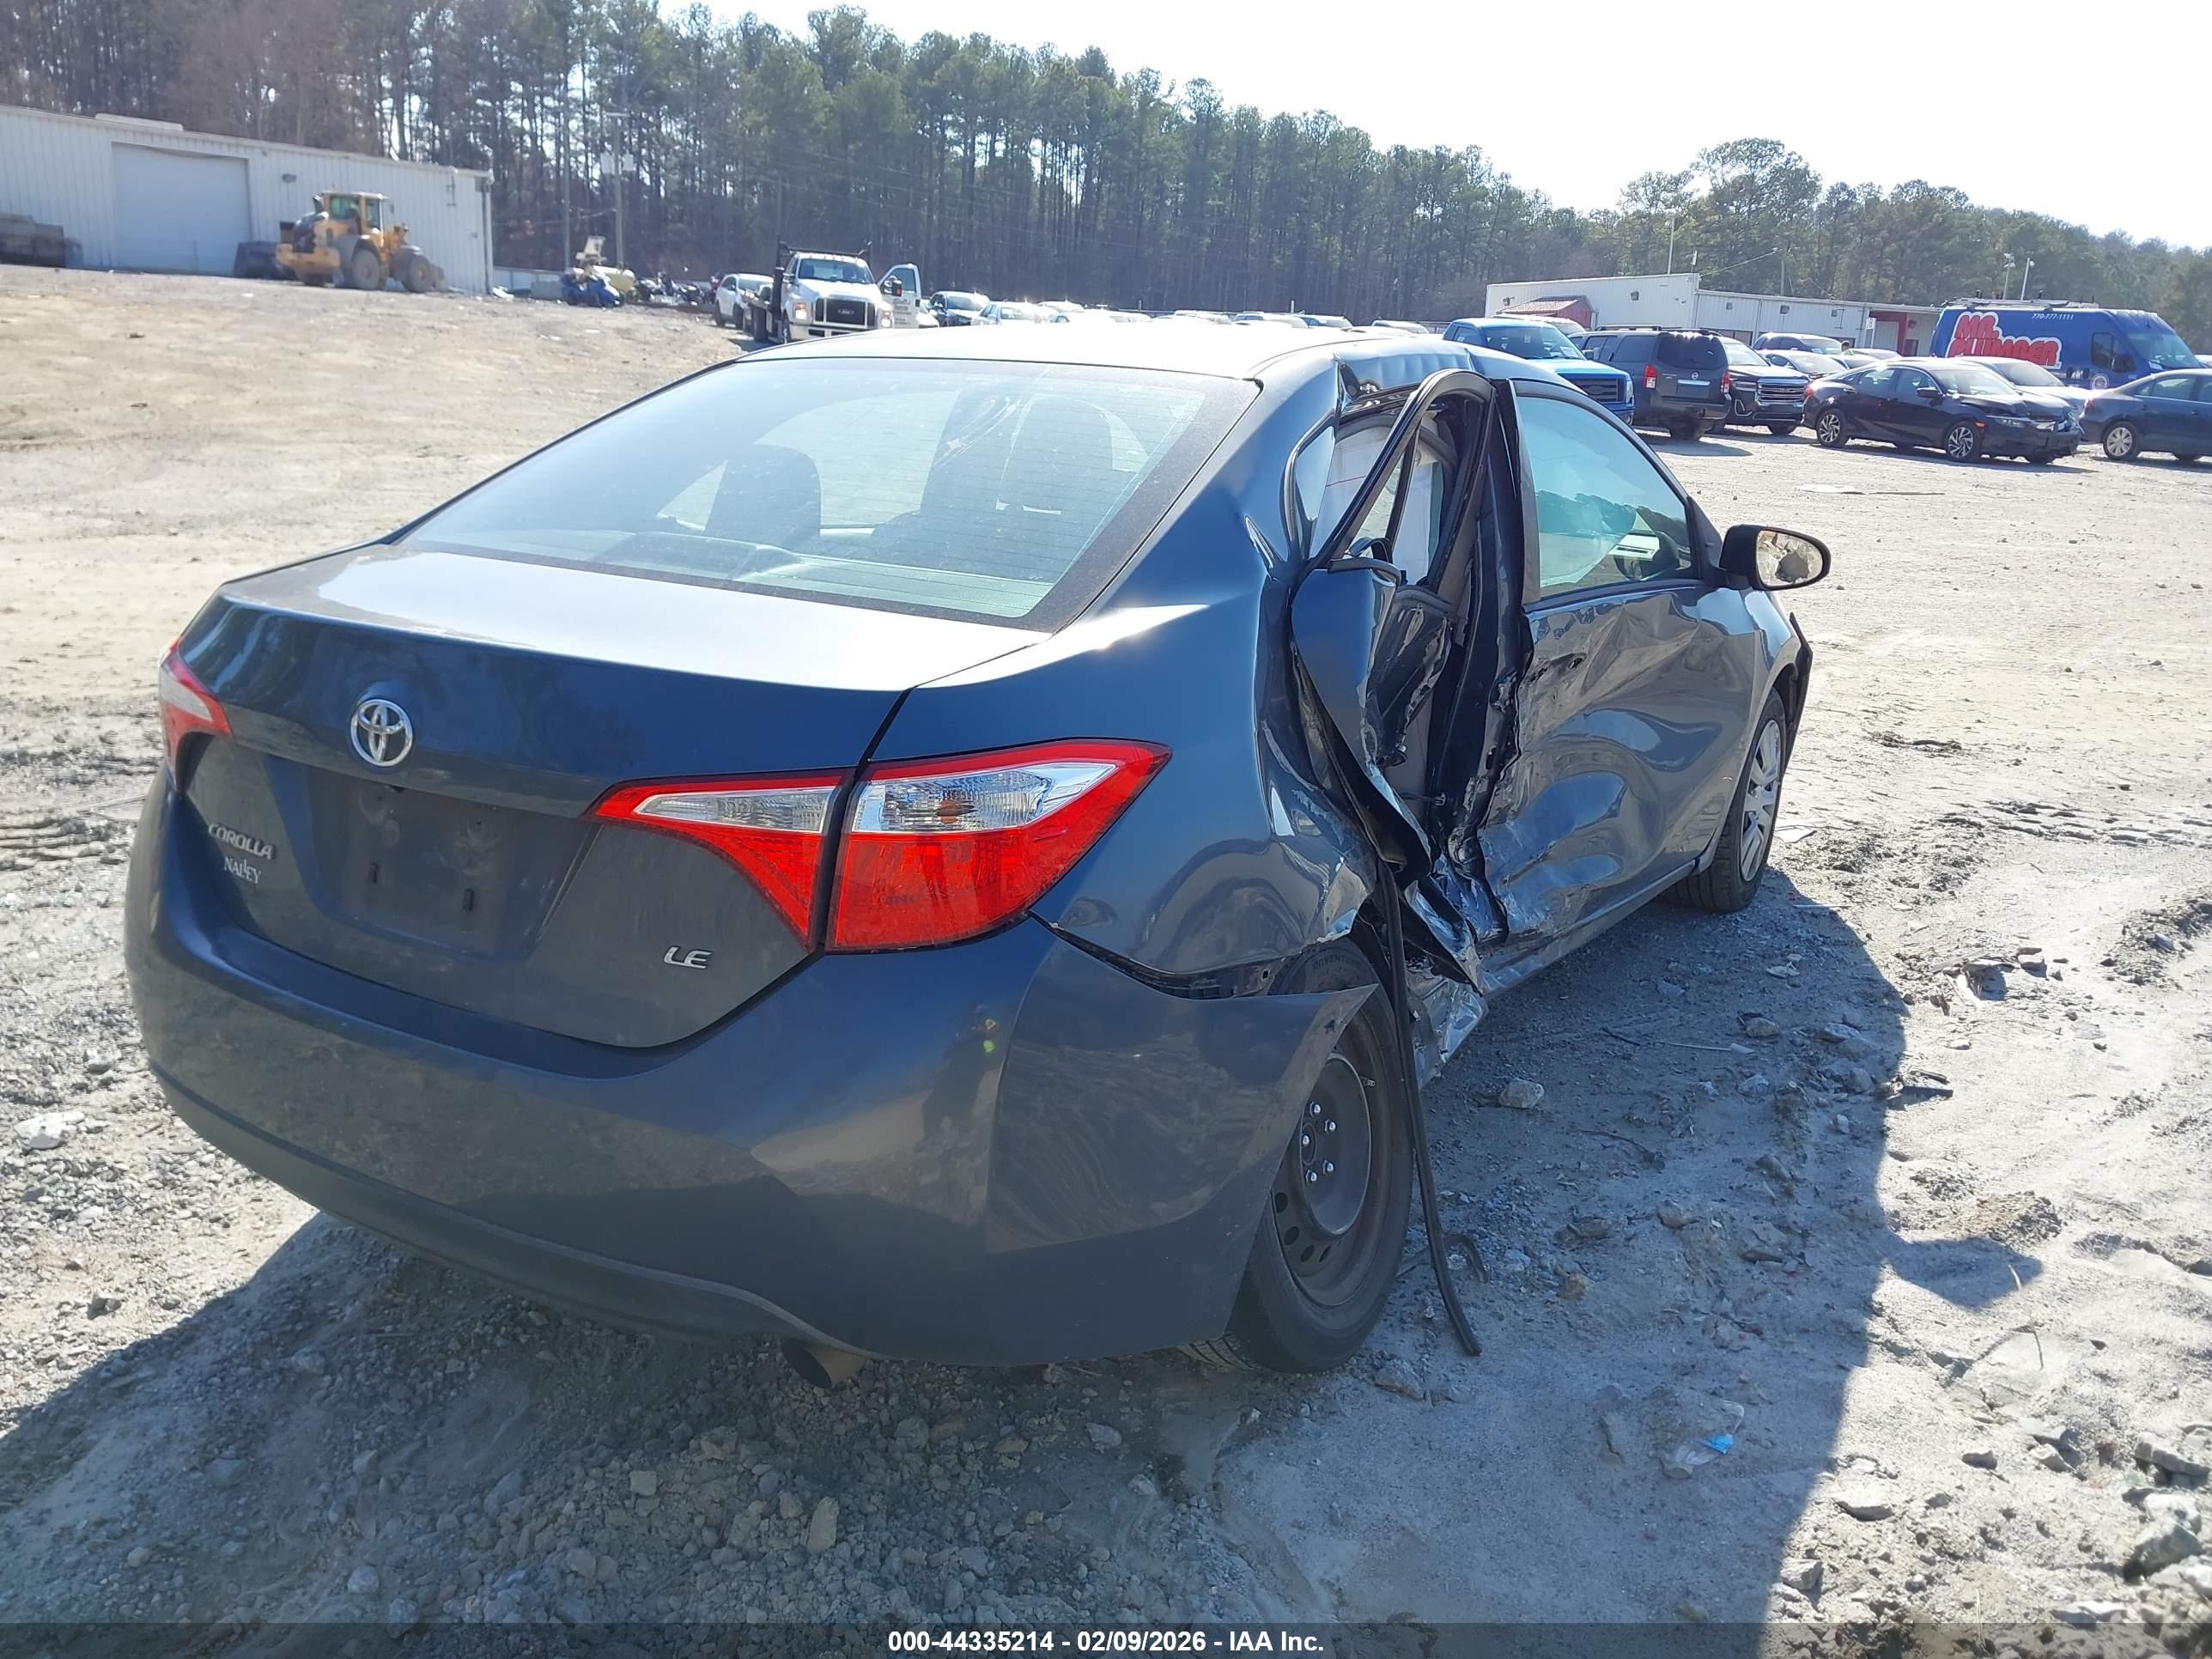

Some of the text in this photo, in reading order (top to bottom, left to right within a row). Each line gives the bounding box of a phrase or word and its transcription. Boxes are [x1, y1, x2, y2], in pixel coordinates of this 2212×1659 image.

[1955, 314, 2000, 338] MR.
[208, 823, 274, 860] COROLLA
[223, 856, 262, 884] NALLEY
[664, 946, 714, 969] LE
